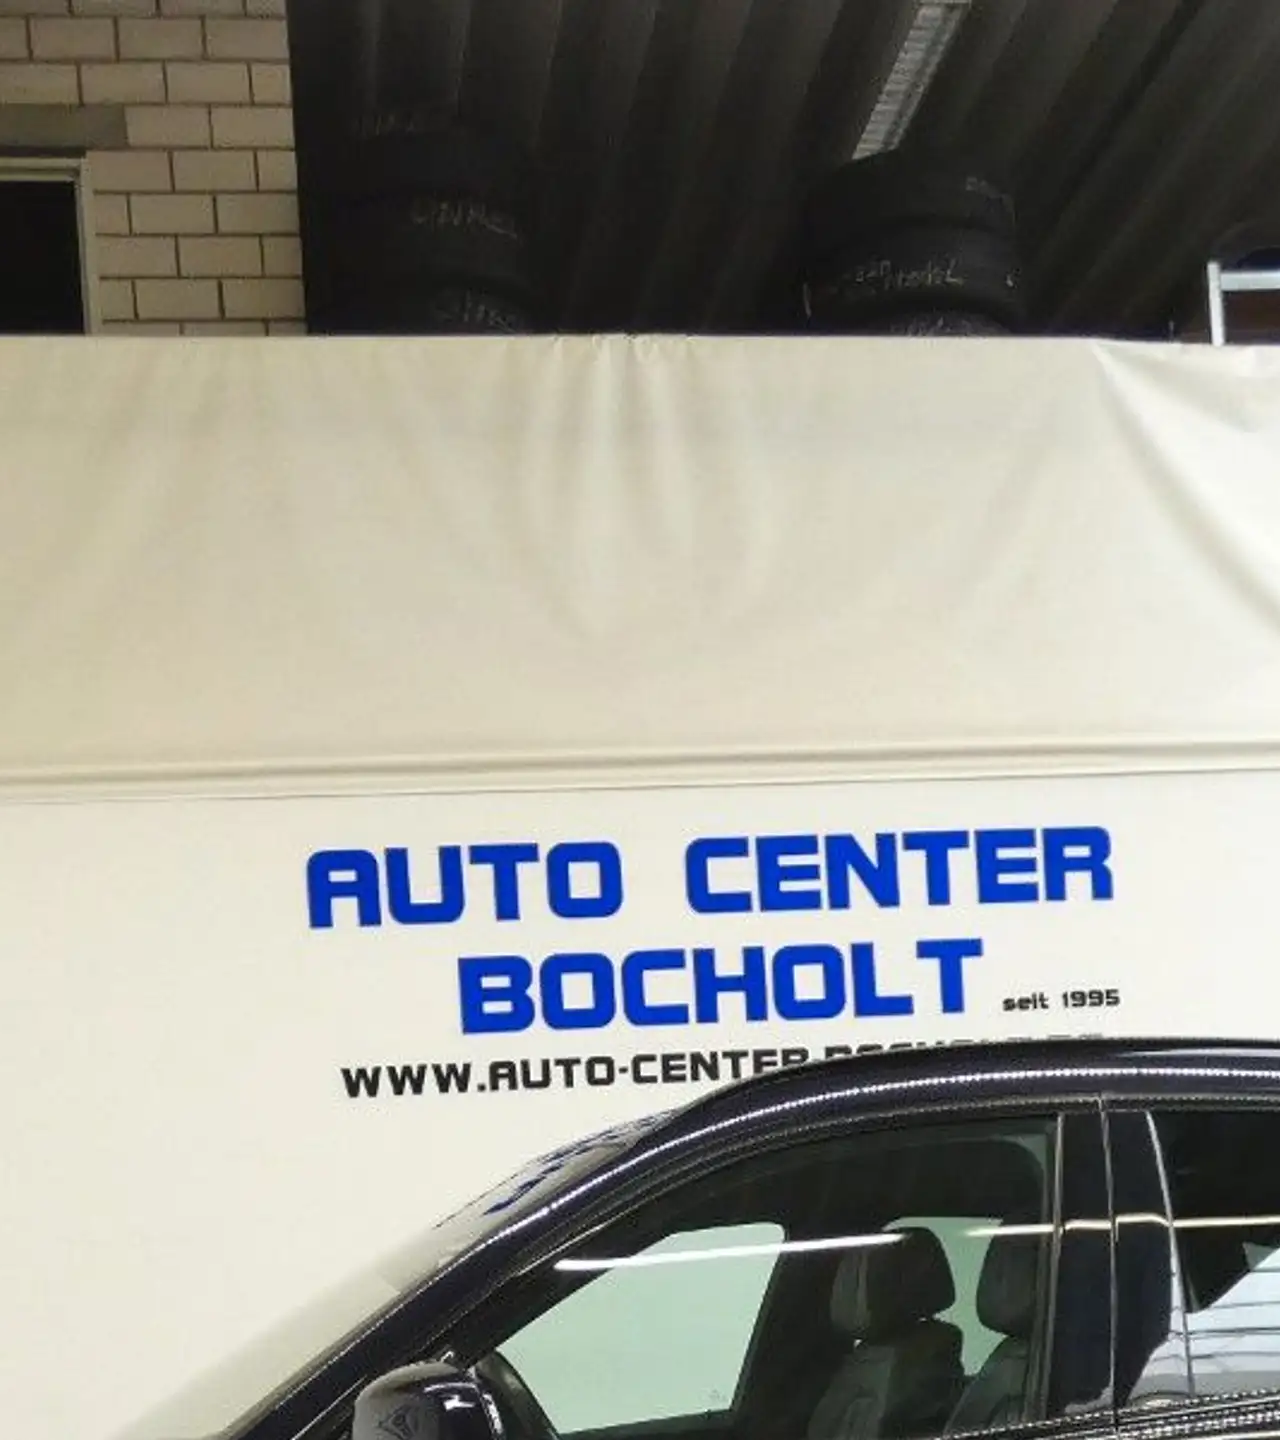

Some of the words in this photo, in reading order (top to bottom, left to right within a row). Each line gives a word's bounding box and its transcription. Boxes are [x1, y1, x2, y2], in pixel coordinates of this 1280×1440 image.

[306, 840, 625, 930] AUTO
[685, 825, 1115, 915] CENTER
[458, 937, 984, 1036] BOCHOLT
[1002, 991, 1049, 1012] seit
[1062, 988, 1121, 1008] 1995
